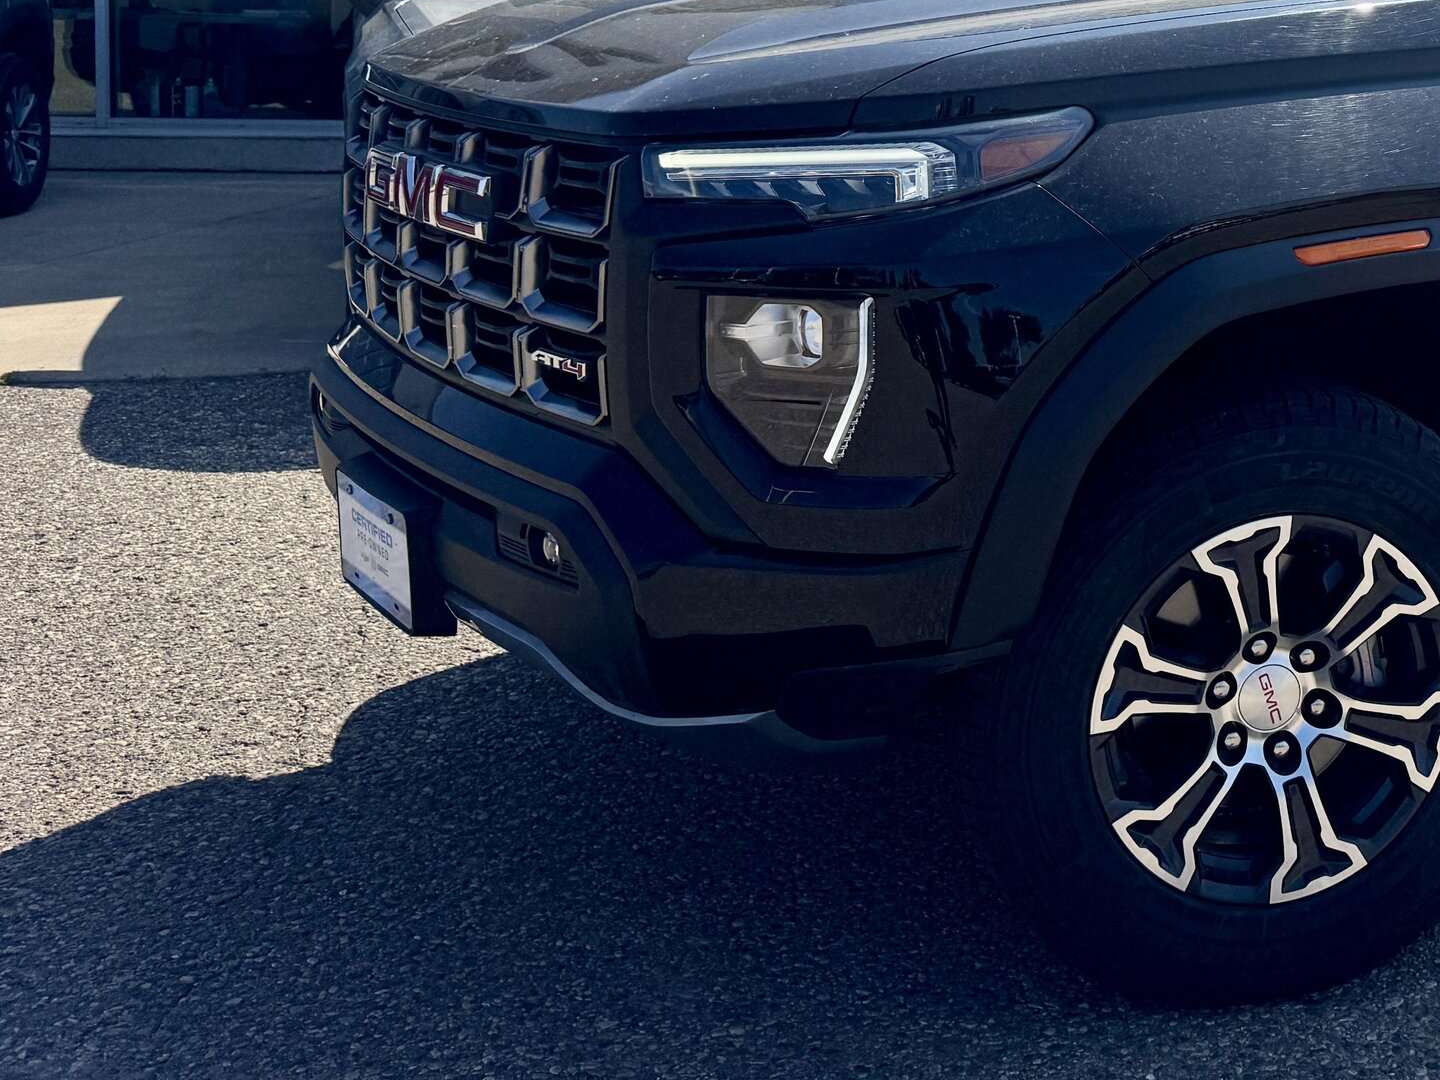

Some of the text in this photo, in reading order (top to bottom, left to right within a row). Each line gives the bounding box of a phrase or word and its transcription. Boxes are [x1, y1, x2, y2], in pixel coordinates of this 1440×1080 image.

[366, 148, 491, 242] GMC
[531, 349, 586, 380] AT4
[351, 508, 393, 549] CERTIFIED
[1259, 673, 1281, 724] GMC
